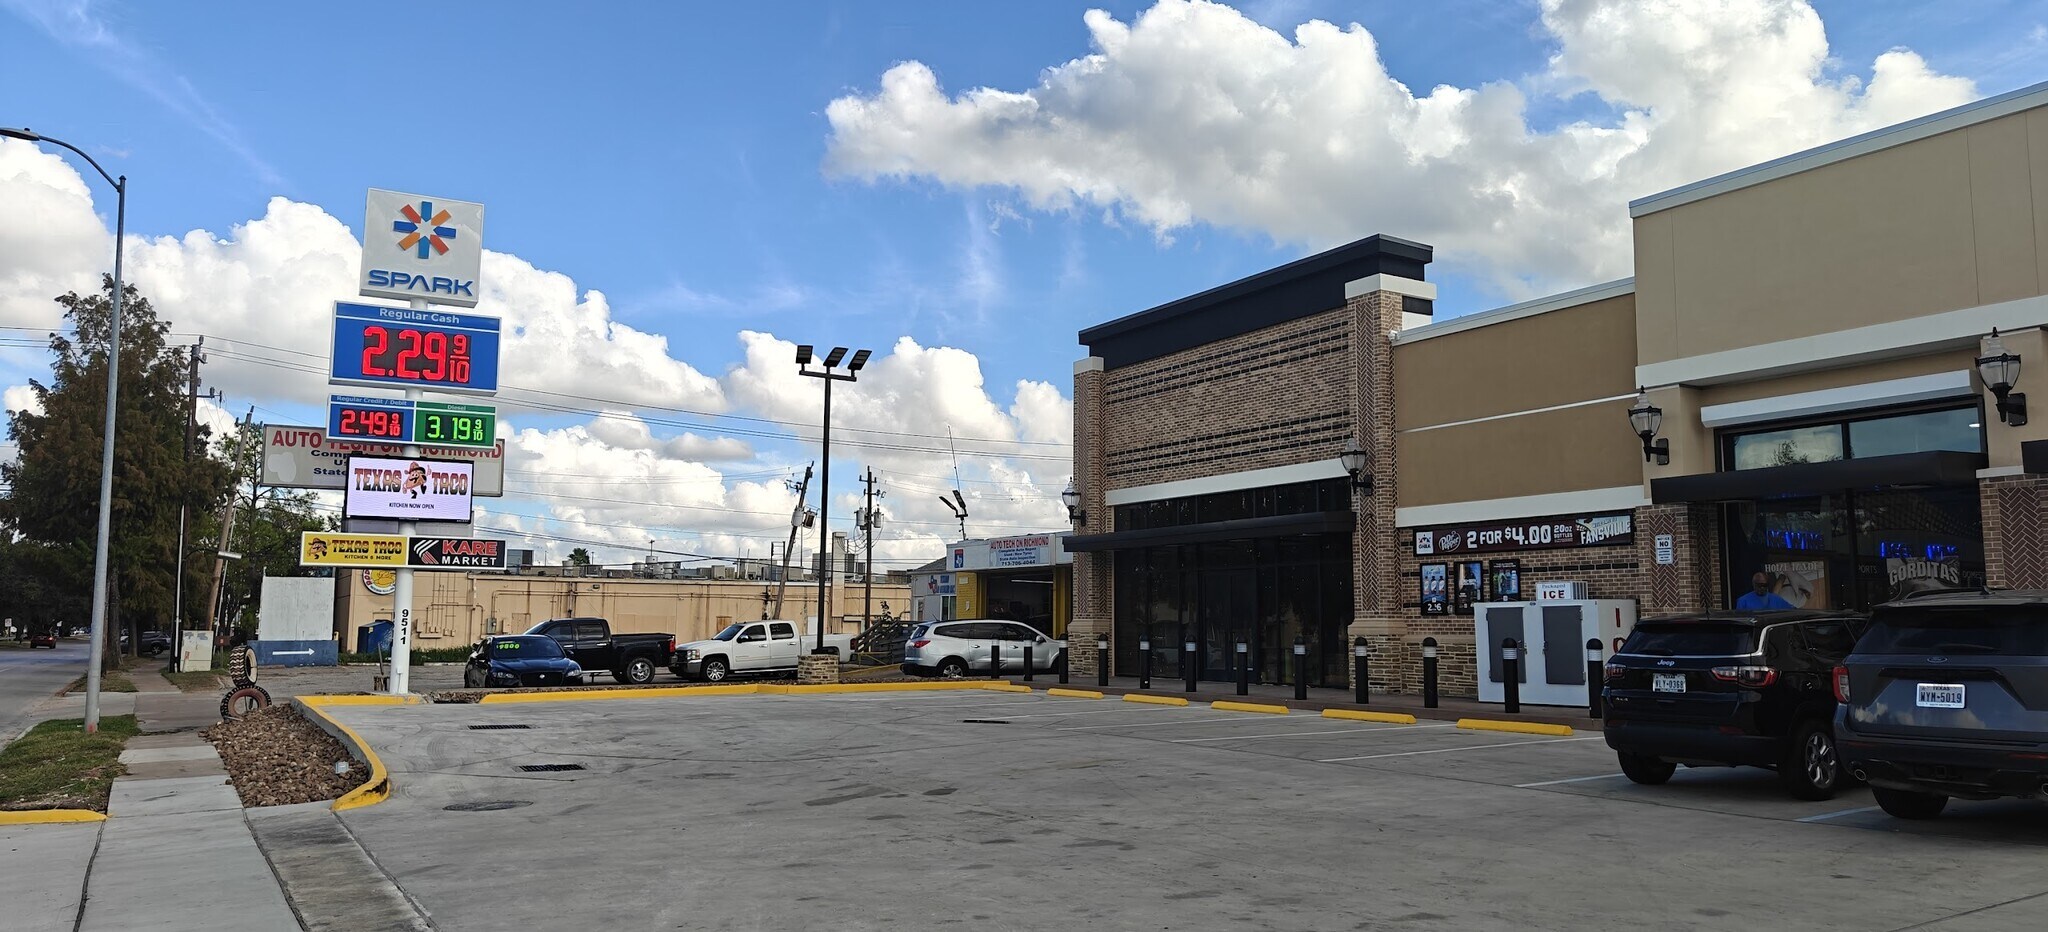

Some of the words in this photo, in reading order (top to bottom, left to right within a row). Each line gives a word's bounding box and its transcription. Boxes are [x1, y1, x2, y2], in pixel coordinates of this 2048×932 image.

[368, 269, 473, 297] SPARK
[379, 308, 428, 321] Regular
[430, 313, 460, 324] Cash
[362, 326, 447, 381] 2.29
[340, 409, 388, 436] 2.49
[271, 430, 322, 448] AUTO
[354, 467, 402, 493] TEXAS
[431, 471, 468, 496] TACO
[990, 540, 1003, 550] AUTO
[1003, 539, 1016, 549] TECH
[1016, 538, 1023, 548] ON
[1023, 536, 1049, 547] RICHMOND
[1466, 531, 1478, 549] 2
[1480, 530, 1503, 545] FOR
[1504, 524, 1552, 545] $4.00
[1580, 520, 1631, 545] FANSVILLE
[331, 539, 370, 554] TEXAS
[373, 540, 403, 555] TACO
[442, 539, 498, 556] KARE
[441, 555, 497, 566] MARKET
[1888, 560, 1959, 586] GORDITAS
[1543, 589, 1565, 599] ICE
[400, 608, 409, 645] 9511
[1657, 659, 1675, 667] Jeep
